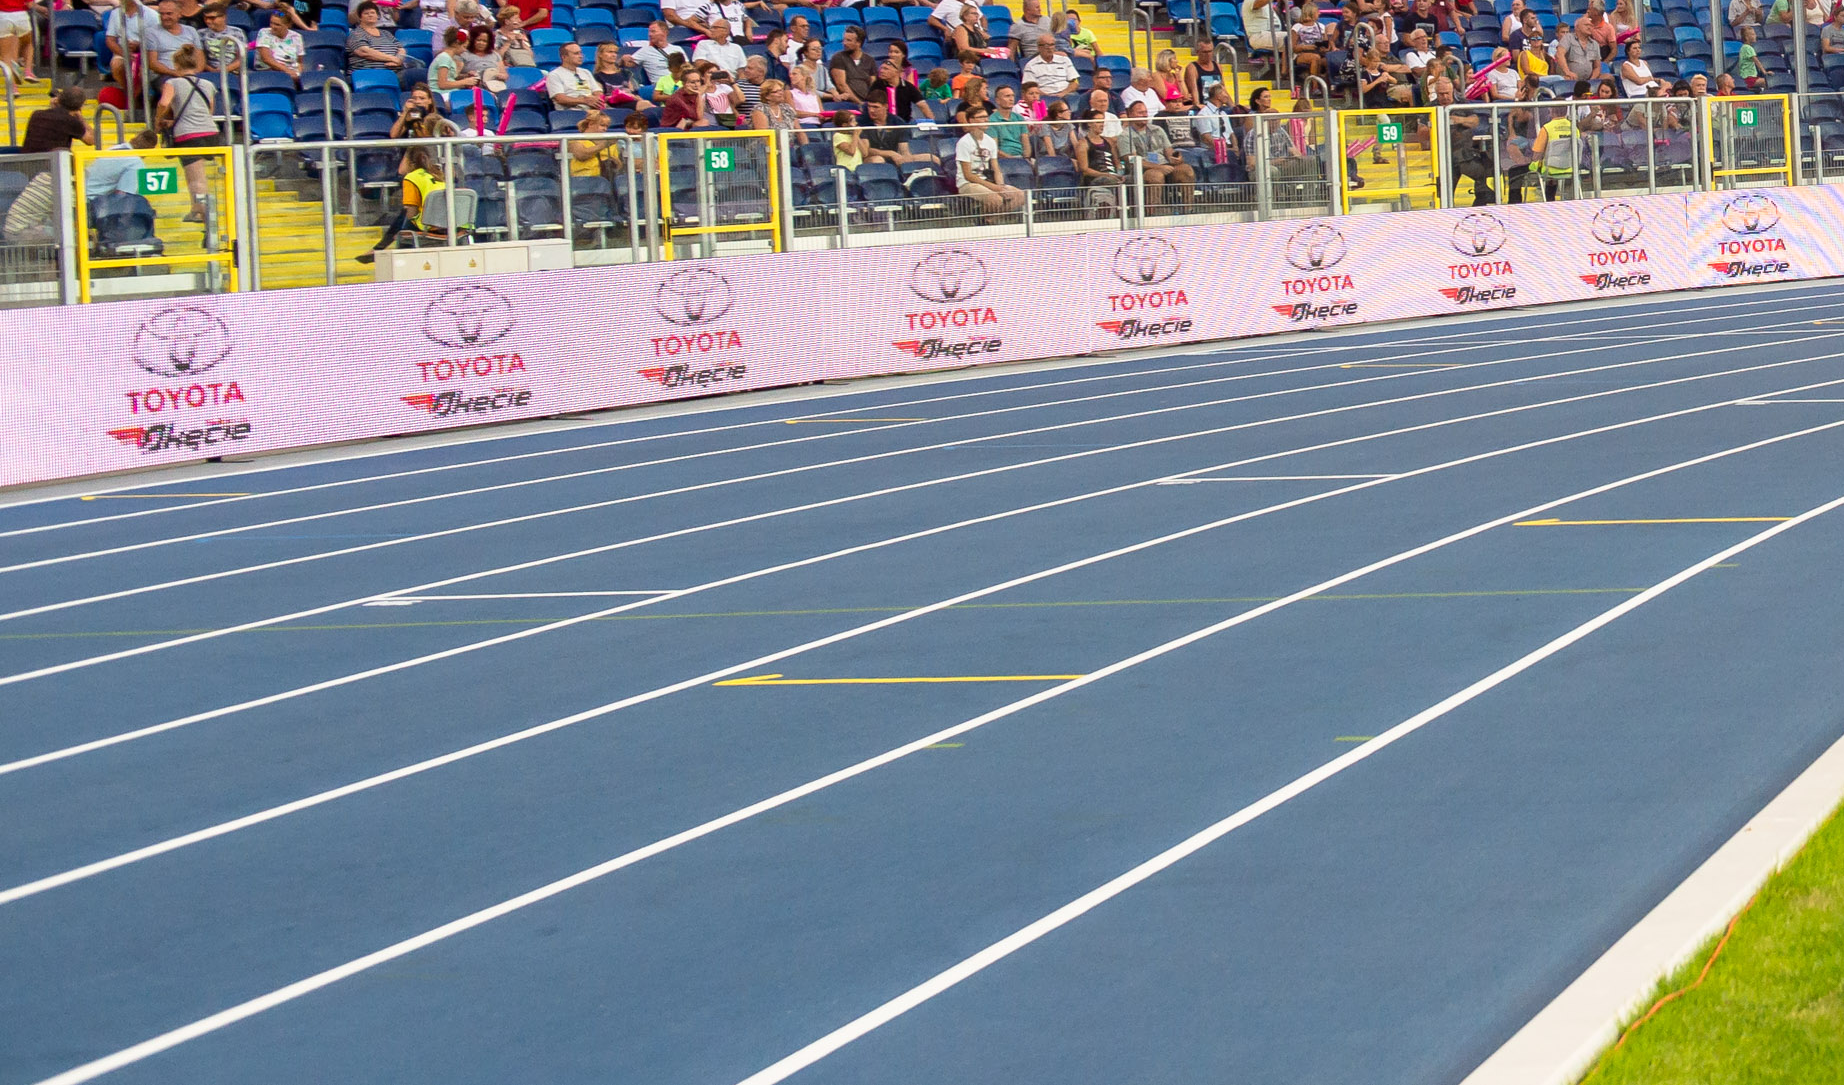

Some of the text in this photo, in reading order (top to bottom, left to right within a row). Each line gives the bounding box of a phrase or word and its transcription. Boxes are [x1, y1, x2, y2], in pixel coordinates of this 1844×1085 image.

[1740, 110, 1754, 125] 60
[1382, 125, 1398, 141] 59
[710, 151, 729, 169] 58
[145, 170, 170, 192] 57
[1588, 250, 1648, 266] TOYOTA
[1721, 239, 1785, 255] TOYOTA
[1448, 261, 1513, 280] TOYOTA
[1283, 274, 1355, 296] TOYOTA
[1109, 289, 1189, 312] TOYOTA
[907, 307, 998, 331] TOYOTA
[650, 329, 743, 357] TOYOTA
[416, 353, 526, 382] TOYOTA
[127, 381, 245, 415] TOYOTA
